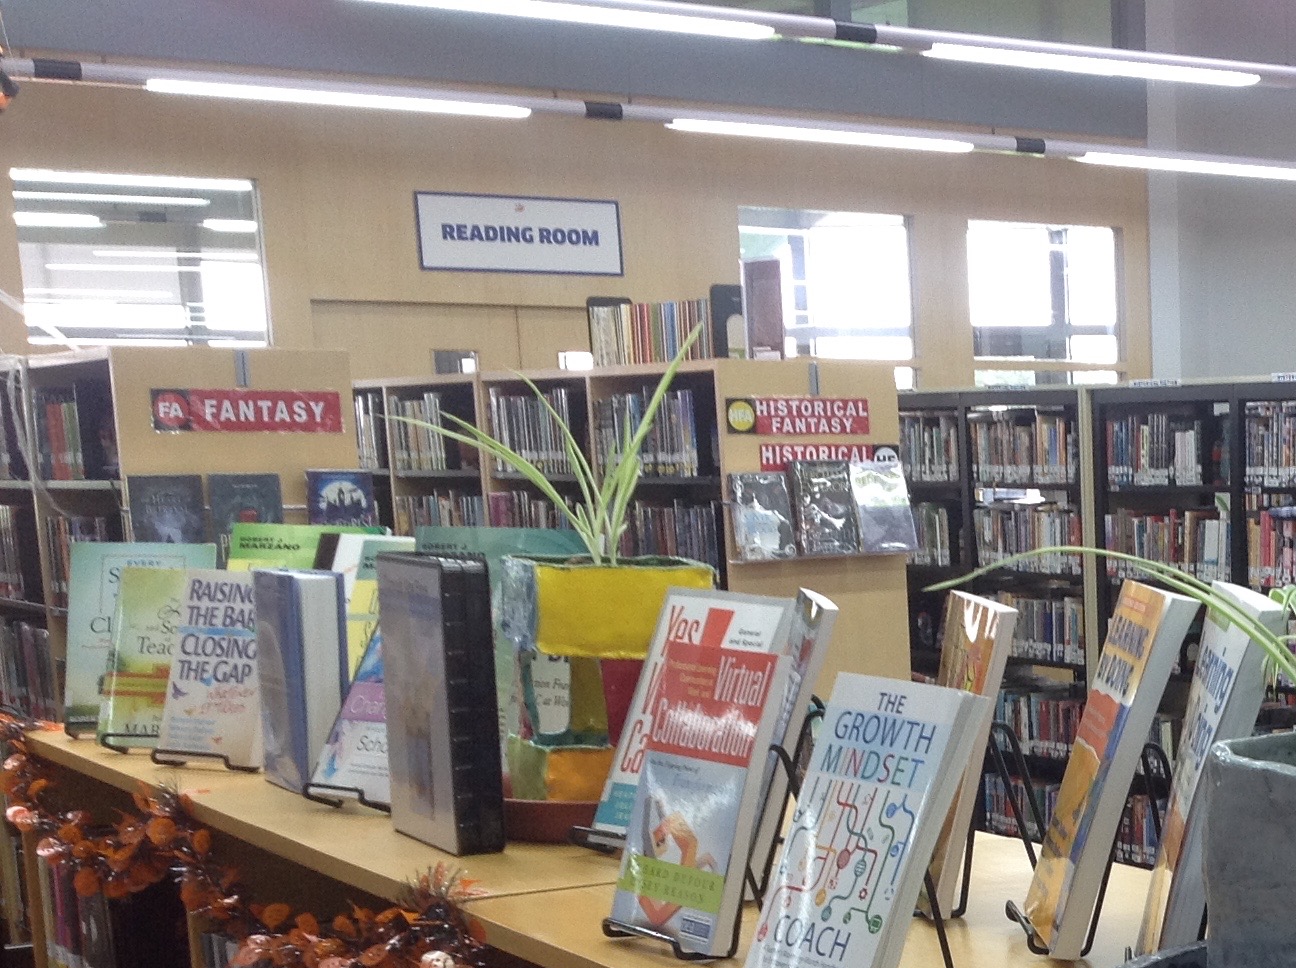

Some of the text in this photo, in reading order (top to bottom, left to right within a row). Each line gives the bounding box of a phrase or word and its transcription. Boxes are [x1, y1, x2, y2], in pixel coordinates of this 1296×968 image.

[442, 223, 599, 247] READING ROOM
[157, 399, 326, 423] FA FANTASY
[756, 400, 868, 417] HISTORICAL
[772, 417, 853, 434] FANTASY
[761, 445, 871, 465] HISTORICAL
[239, 542, 300, 551] MARZANO
[187, 604, 219, 627] THE
[661, 605, 700, 645] Yes
[738, 628, 761, 637] General
[136, 636, 175, 655] Teac
[180, 633, 257, 660] CLOSING
[178, 658, 253, 685] THE GAP
[714, 655, 773, 708] Virtual
[877, 691, 908, 715] THE
[651, 697, 758, 760] Collaboration
[833, 710, 937, 754] GROWTH
[820, 745, 926, 787] MINDSET
[773, 913, 852, 962] COACH
